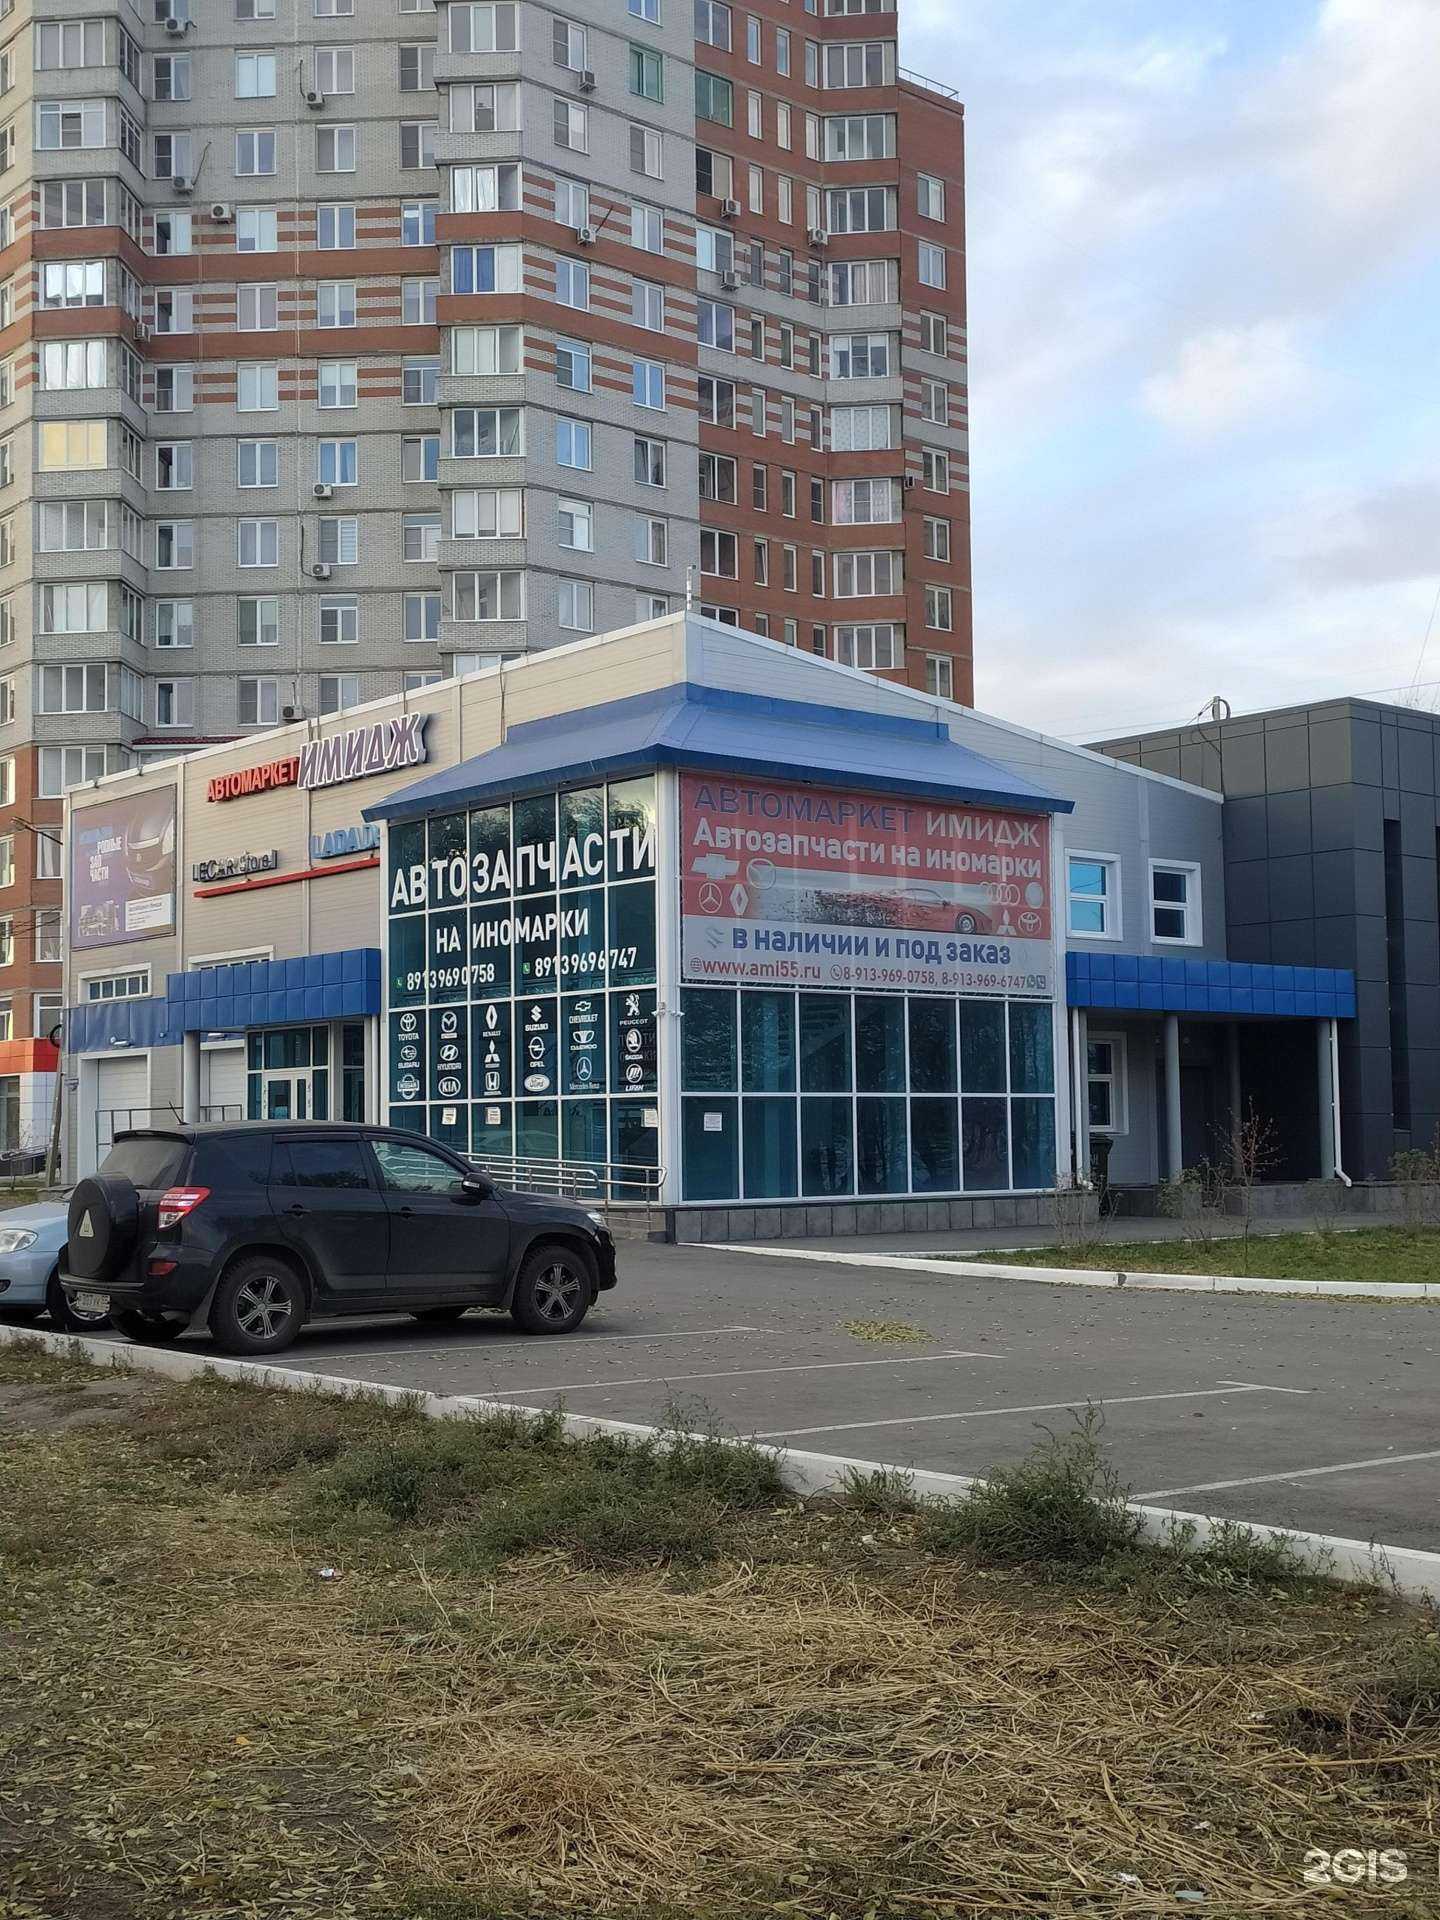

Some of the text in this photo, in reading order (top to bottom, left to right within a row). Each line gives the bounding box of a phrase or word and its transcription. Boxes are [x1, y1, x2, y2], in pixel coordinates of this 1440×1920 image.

[207, 712, 423, 802] АВТОМАРКЕТ ИМИДЖ
[695, 785, 1040, 849] АВТОМАРКЕТ ИМИДЖ
[693, 818, 1042, 881] Автозапчасти на иномарки
[391, 825, 657, 908] АВТОЗАПЧАСТИ
[436, 908, 589, 953] НА ИНОМАРКИ
[534, 946, 637, 978] 89139696747
[755, 930, 870, 956] наличии
[875, 937, 888, 957] и
[895, 938, 942, 964] под
[946, 941, 1011, 965] заказ
[406, 963, 495, 991] 89139690758
[702, 959, 1025, 989] www.ami55.ru 8-913-969-0758, 8-913-969-6747
[397, 1033, 420, 1041] TOYOTA
[619, 1018, 648, 1026] PEUGEOT
[442, 1081, 457, 1092] KIA
